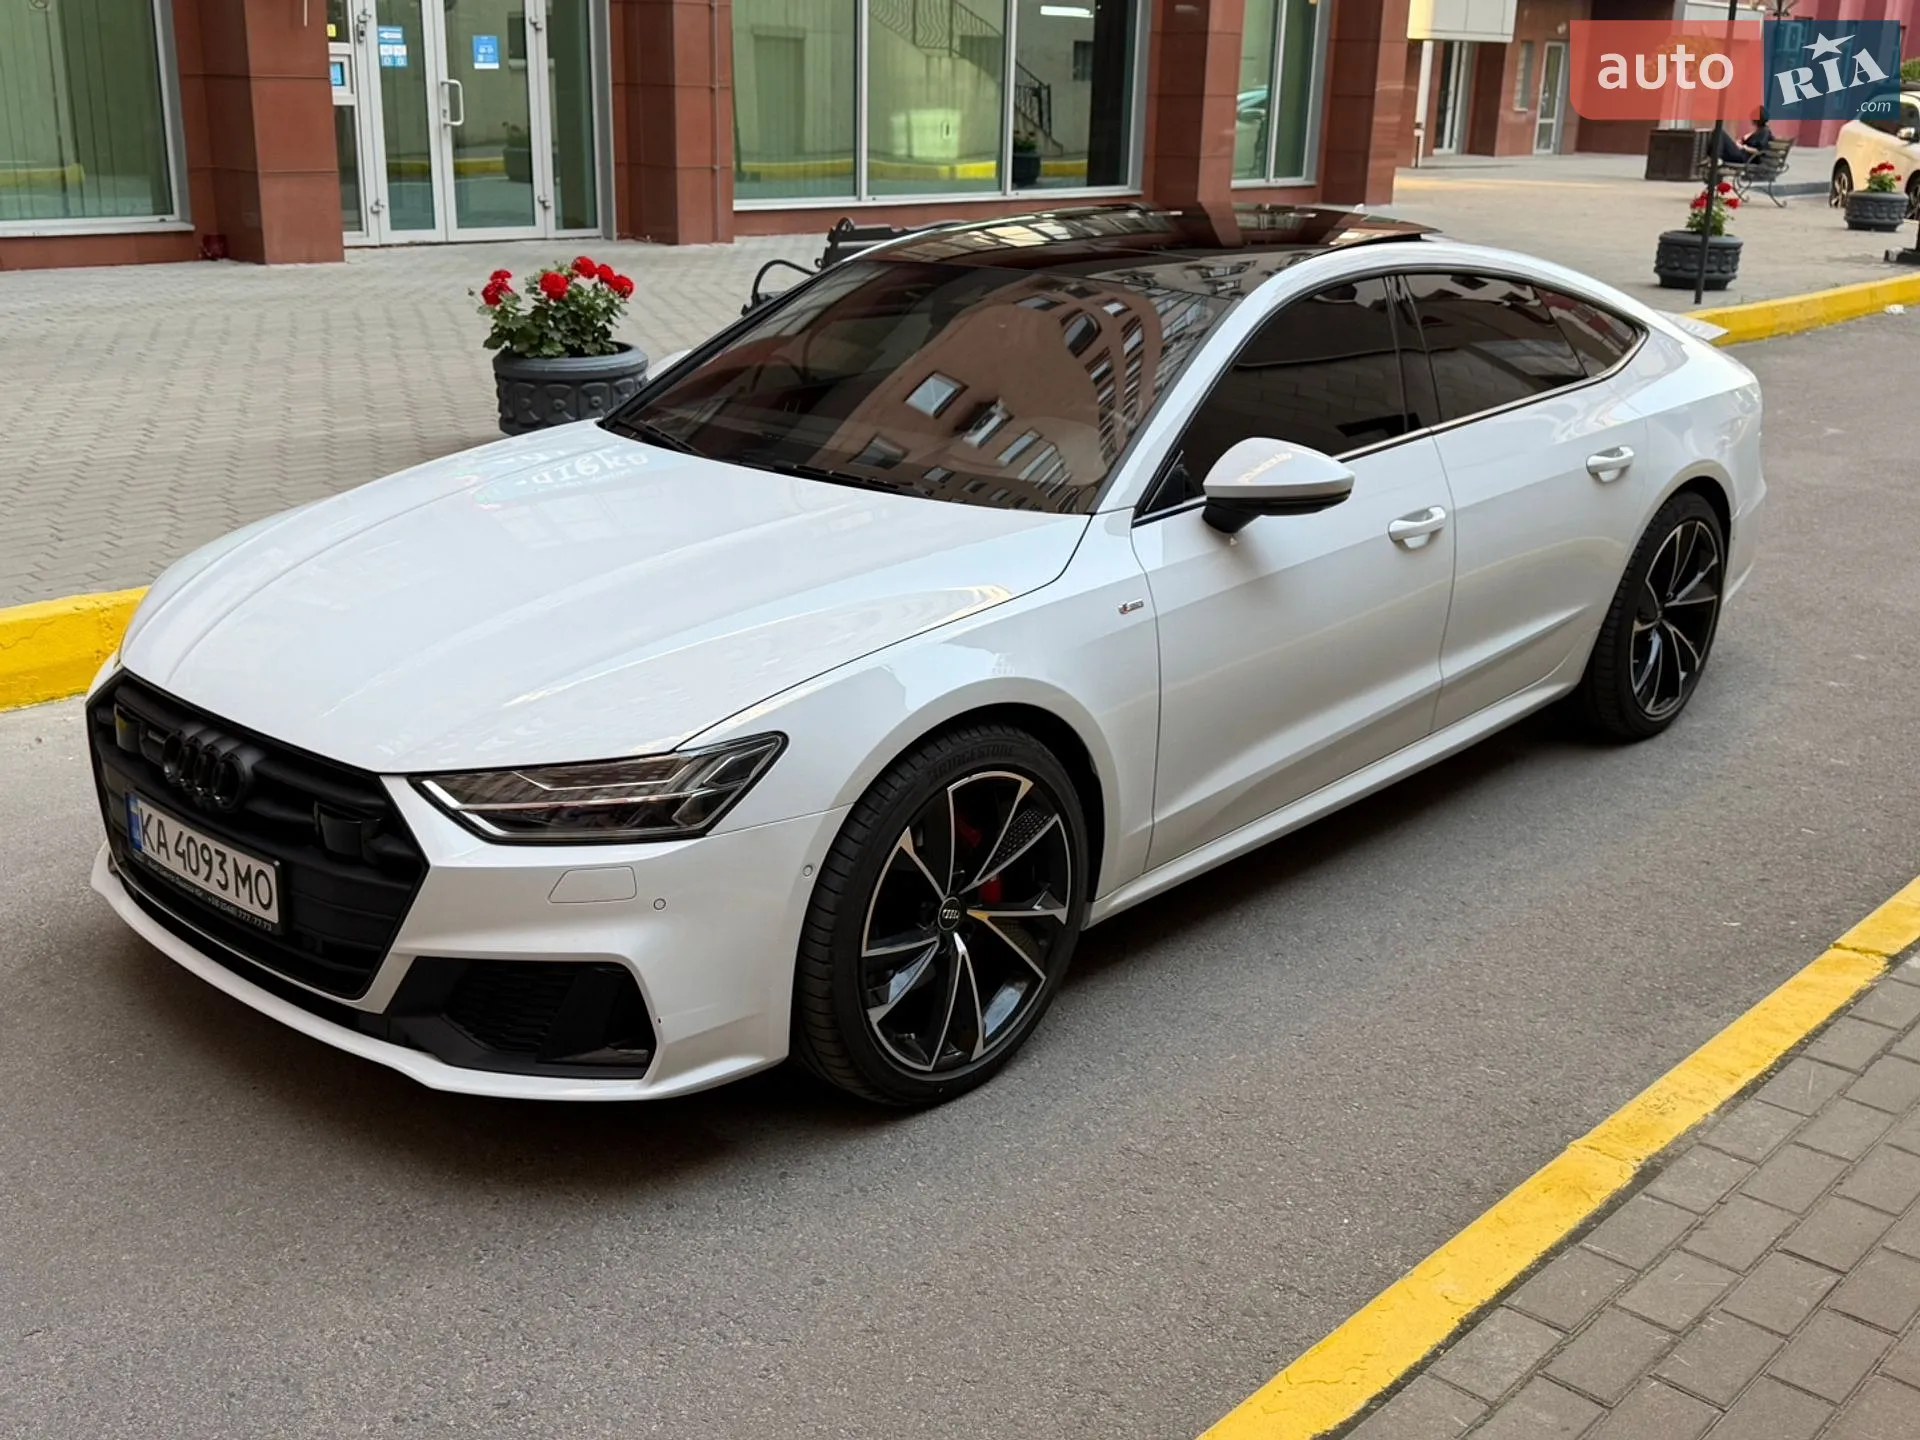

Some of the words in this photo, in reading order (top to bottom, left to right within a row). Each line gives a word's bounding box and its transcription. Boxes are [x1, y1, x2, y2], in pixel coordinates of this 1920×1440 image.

[139, 808, 171, 861] KA
[174, 831, 229, 890] 4093
[233, 857, 273, 910] MO
